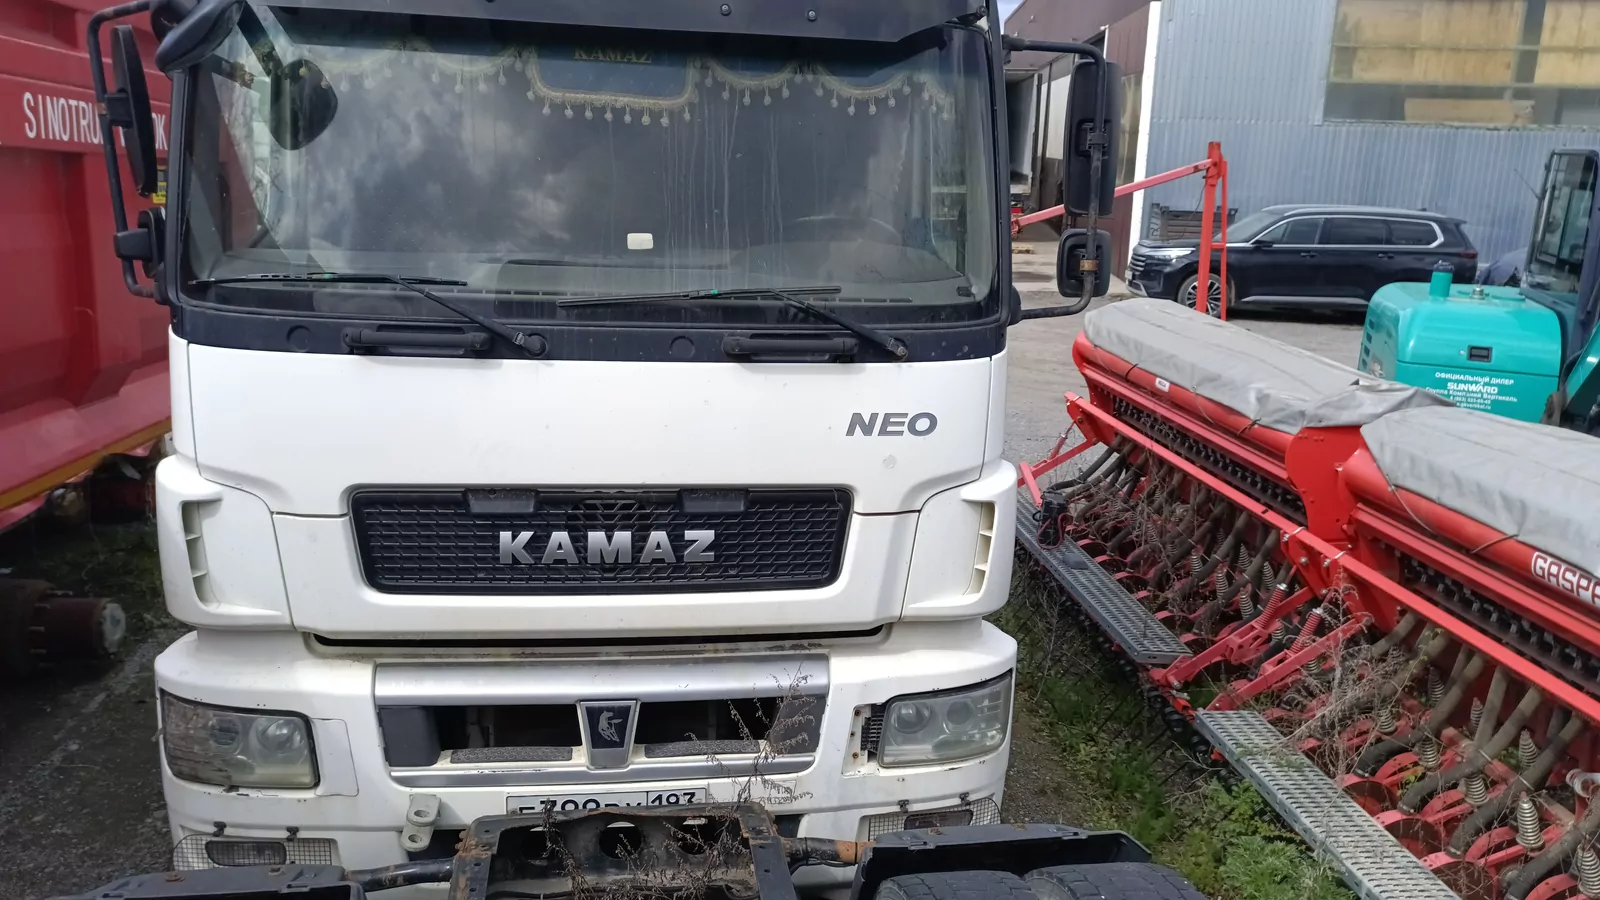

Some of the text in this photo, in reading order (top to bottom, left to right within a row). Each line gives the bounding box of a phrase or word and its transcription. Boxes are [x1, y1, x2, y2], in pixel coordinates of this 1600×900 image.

[23, 91, 105, 145] SINOTRU
[1435, 372, 1515, 386] ОФИЦИАЛЬНЫЙ ДИЛЕР
[1447, 382, 1498, 394] SUNWARD
[1483, 393, 1518, 402] Вертикаль
[845, 412, 938, 437] NEO
[499, 530, 715, 564] KAMAZ
